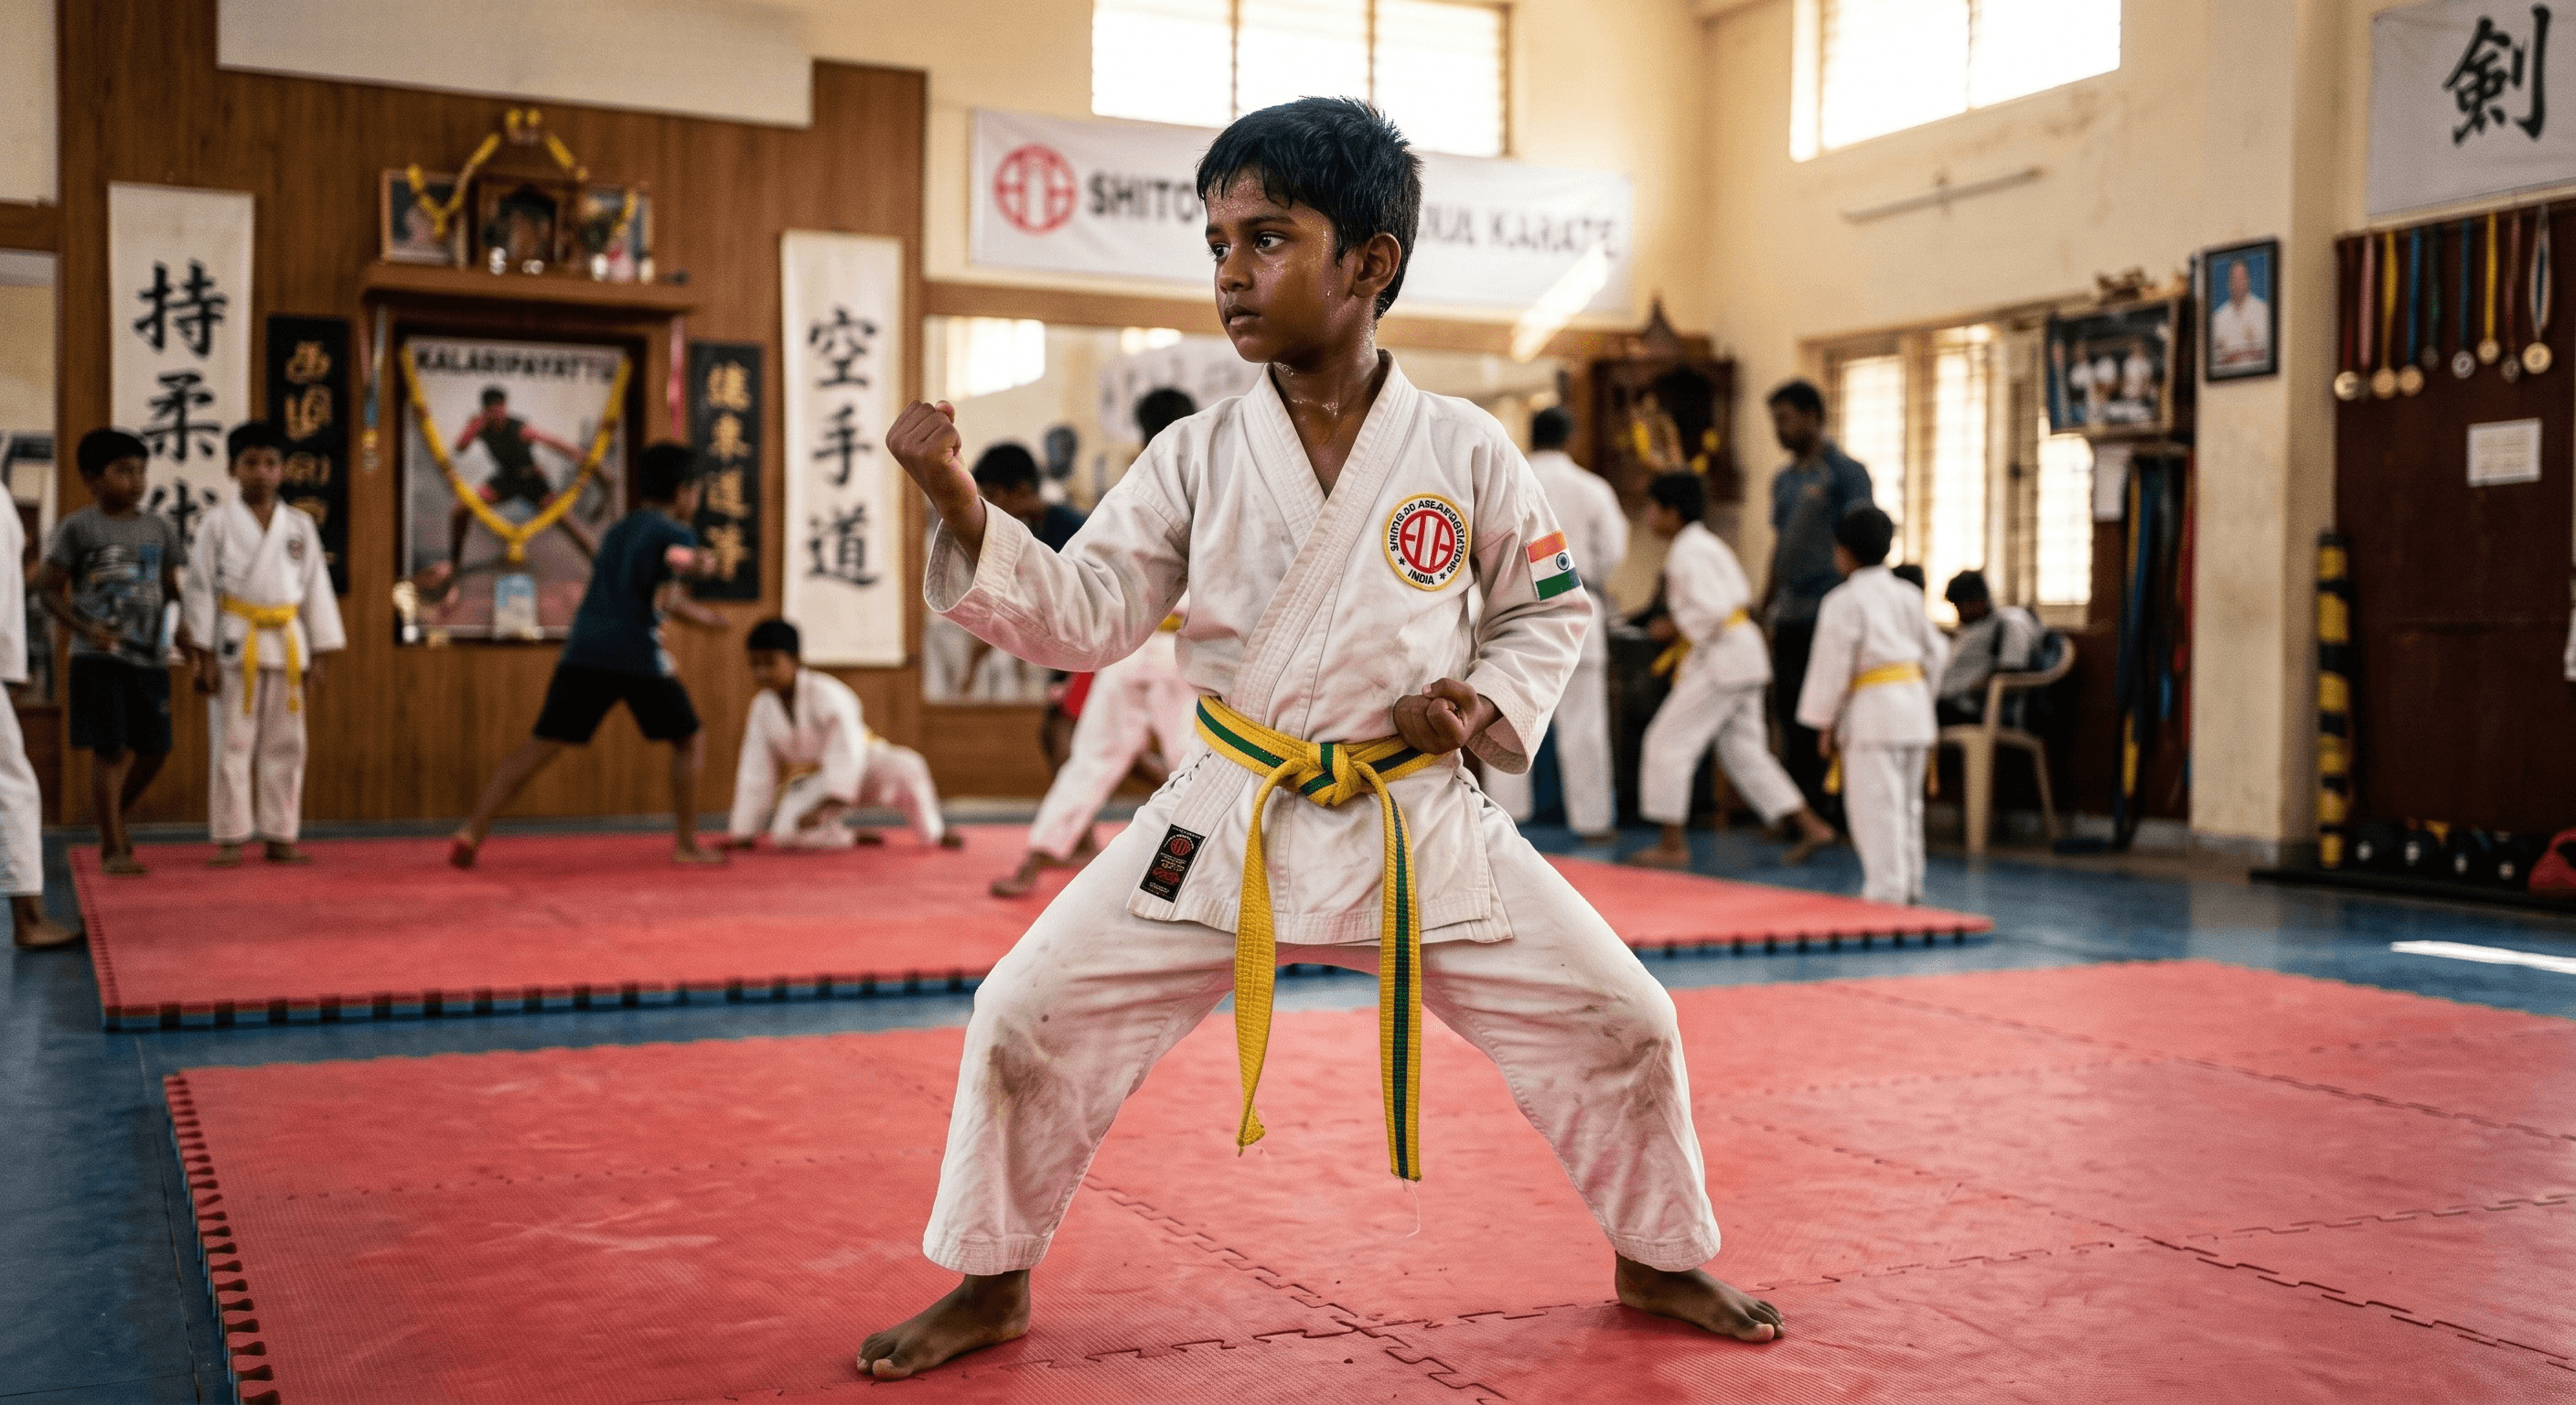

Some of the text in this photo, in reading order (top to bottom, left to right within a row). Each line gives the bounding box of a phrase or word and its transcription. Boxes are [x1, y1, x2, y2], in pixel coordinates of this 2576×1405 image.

[806, 306, 881, 588] 空手道
[1407, 568, 1435, 585] INDIA
